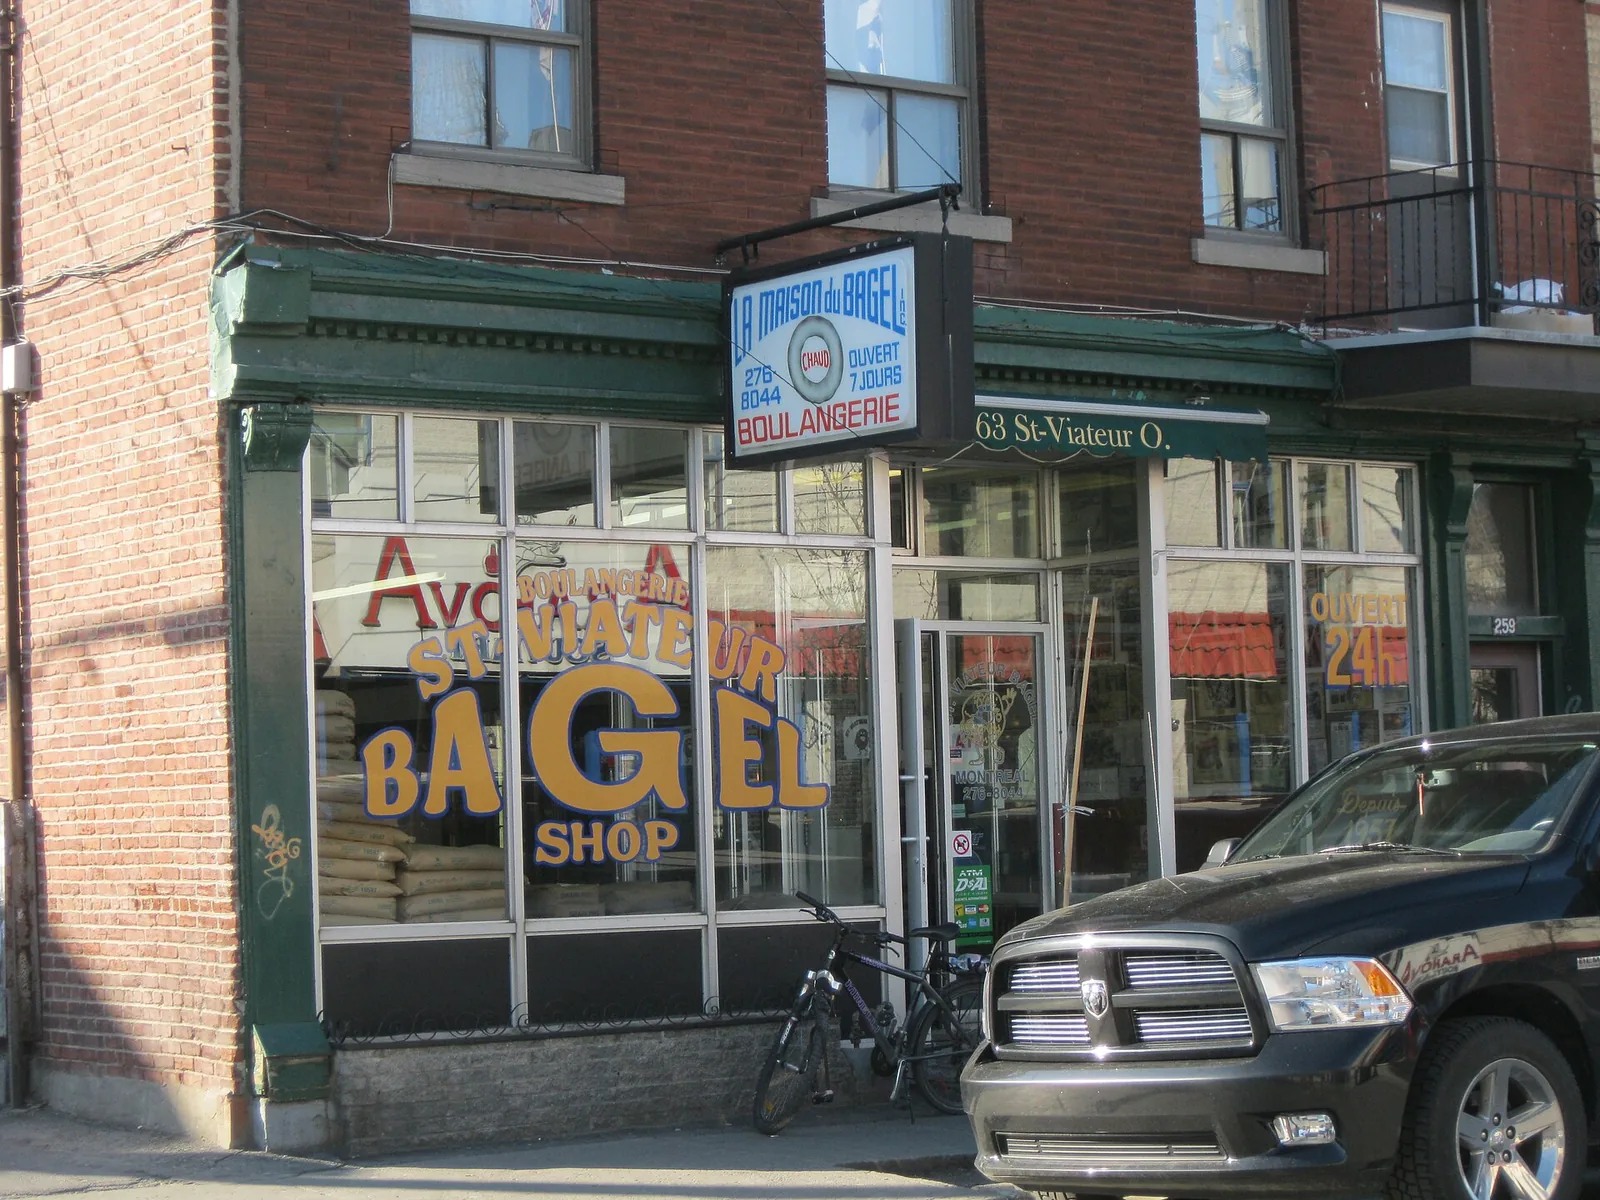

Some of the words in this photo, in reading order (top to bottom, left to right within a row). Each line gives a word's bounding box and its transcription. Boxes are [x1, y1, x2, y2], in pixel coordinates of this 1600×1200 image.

[733, 295, 752, 367] LA
[758, 279, 823, 342] MAISON
[824, 277, 841, 315] du
[843, 263, 906, 337] BAGEL
[802, 349, 830, 372] CHAUD
[849, 341, 900, 369] OUVERT
[745, 364, 773, 388] 276
[850, 372, 857, 392] 7
[859, 365, 902, 391] JOURS
[741, 386, 782, 410] 8044
[737, 393, 900, 445] BOULANGERIE
[975, 411, 1007, 440] 63
[1014, 413, 1133, 448] St-Viateur
[1140, 421, 1171, 450] O.
[516, 567, 690, 607] BOULANGERIE
[1310, 592, 1408, 623] OUVERT
[1493, 617, 1516, 634] 259
[406, 618, 491, 700] ST
[501, 598, 786, 703] VIATEUR
[1324, 625, 1397, 690] 24h
[951, 662, 1006, 696] VIATEUR
[1008, 669, 1038, 725] BAGEL
[362, 661, 831, 816] BAGEL
[955, 769, 1030, 785] MONTREAL
[962, 786, 1025, 801] 276-8044
[1336, 787, 1407, 818] Depuis
[534, 820, 679, 867] SHOP
[959, 869, 983, 877] ATM
